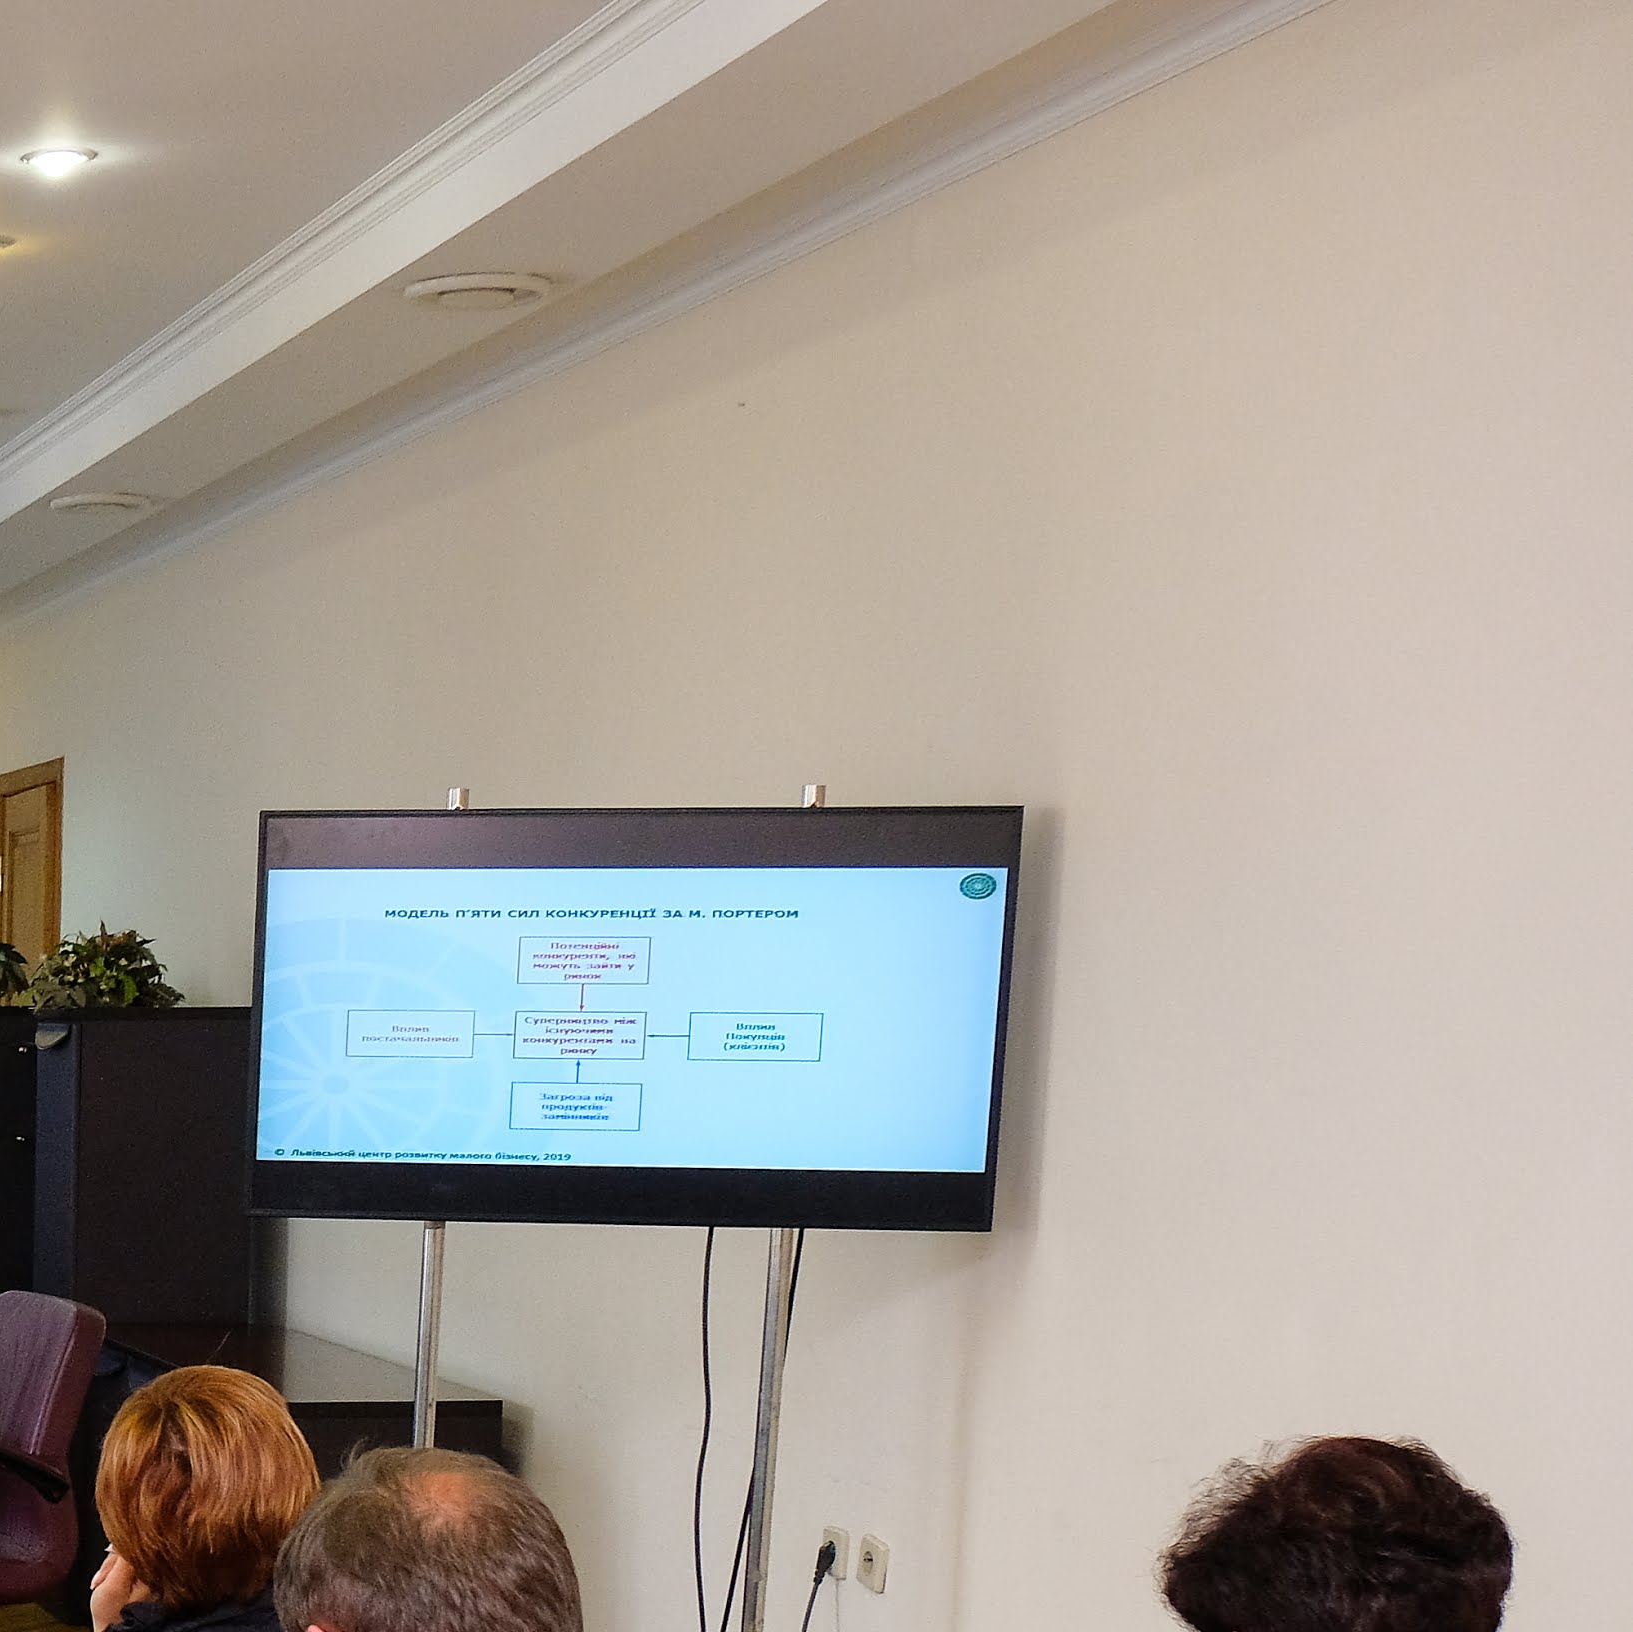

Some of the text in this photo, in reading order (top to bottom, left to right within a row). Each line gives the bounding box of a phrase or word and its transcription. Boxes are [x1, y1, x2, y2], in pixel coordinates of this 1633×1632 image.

[384, 909, 449, 918] МОДЕЛЬ
[508, 909, 540, 918] СИЛ
[546, 907, 657, 919] КОНКУРЕНЦІЇ
[663, 909, 683, 918] ЗА
[689, 909, 706, 918] М.
[712, 909, 799, 918] ПОРТЕРОМ
[543, 1153, 571, 1161] 2019
